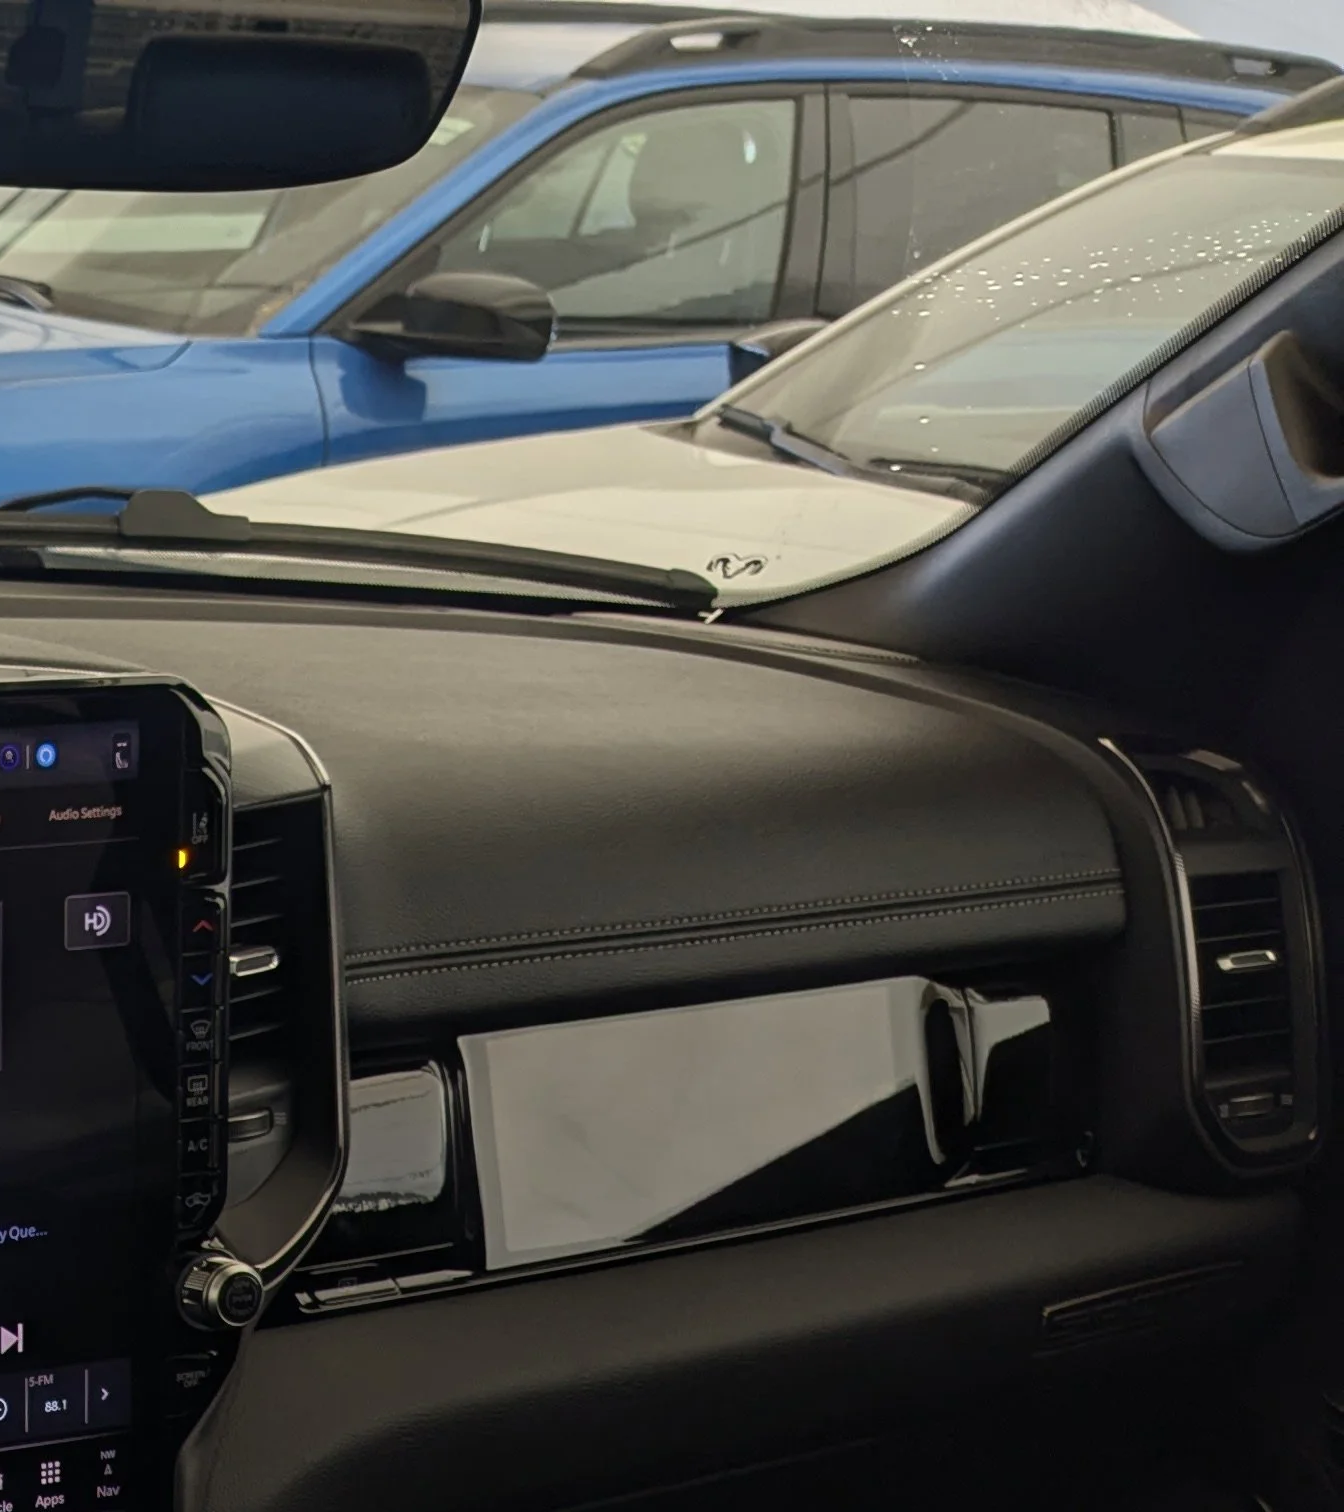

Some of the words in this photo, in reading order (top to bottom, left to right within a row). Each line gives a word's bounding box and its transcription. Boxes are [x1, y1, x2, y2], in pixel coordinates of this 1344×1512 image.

[48, 808, 79, 822] Audio
[81, 805, 123, 820] Settings
[186, 1040, 214, 1052] FRONT
[187, 1138, 209, 1153] A/C
[29, 1374, 54, 1388] 5-FM
[44, 1399, 68, 1413] 88.1
[100, 1450, 116, 1460] NW
[97, 1485, 120, 1498] Nav
[35, 1493, 65, 1509] Apps
